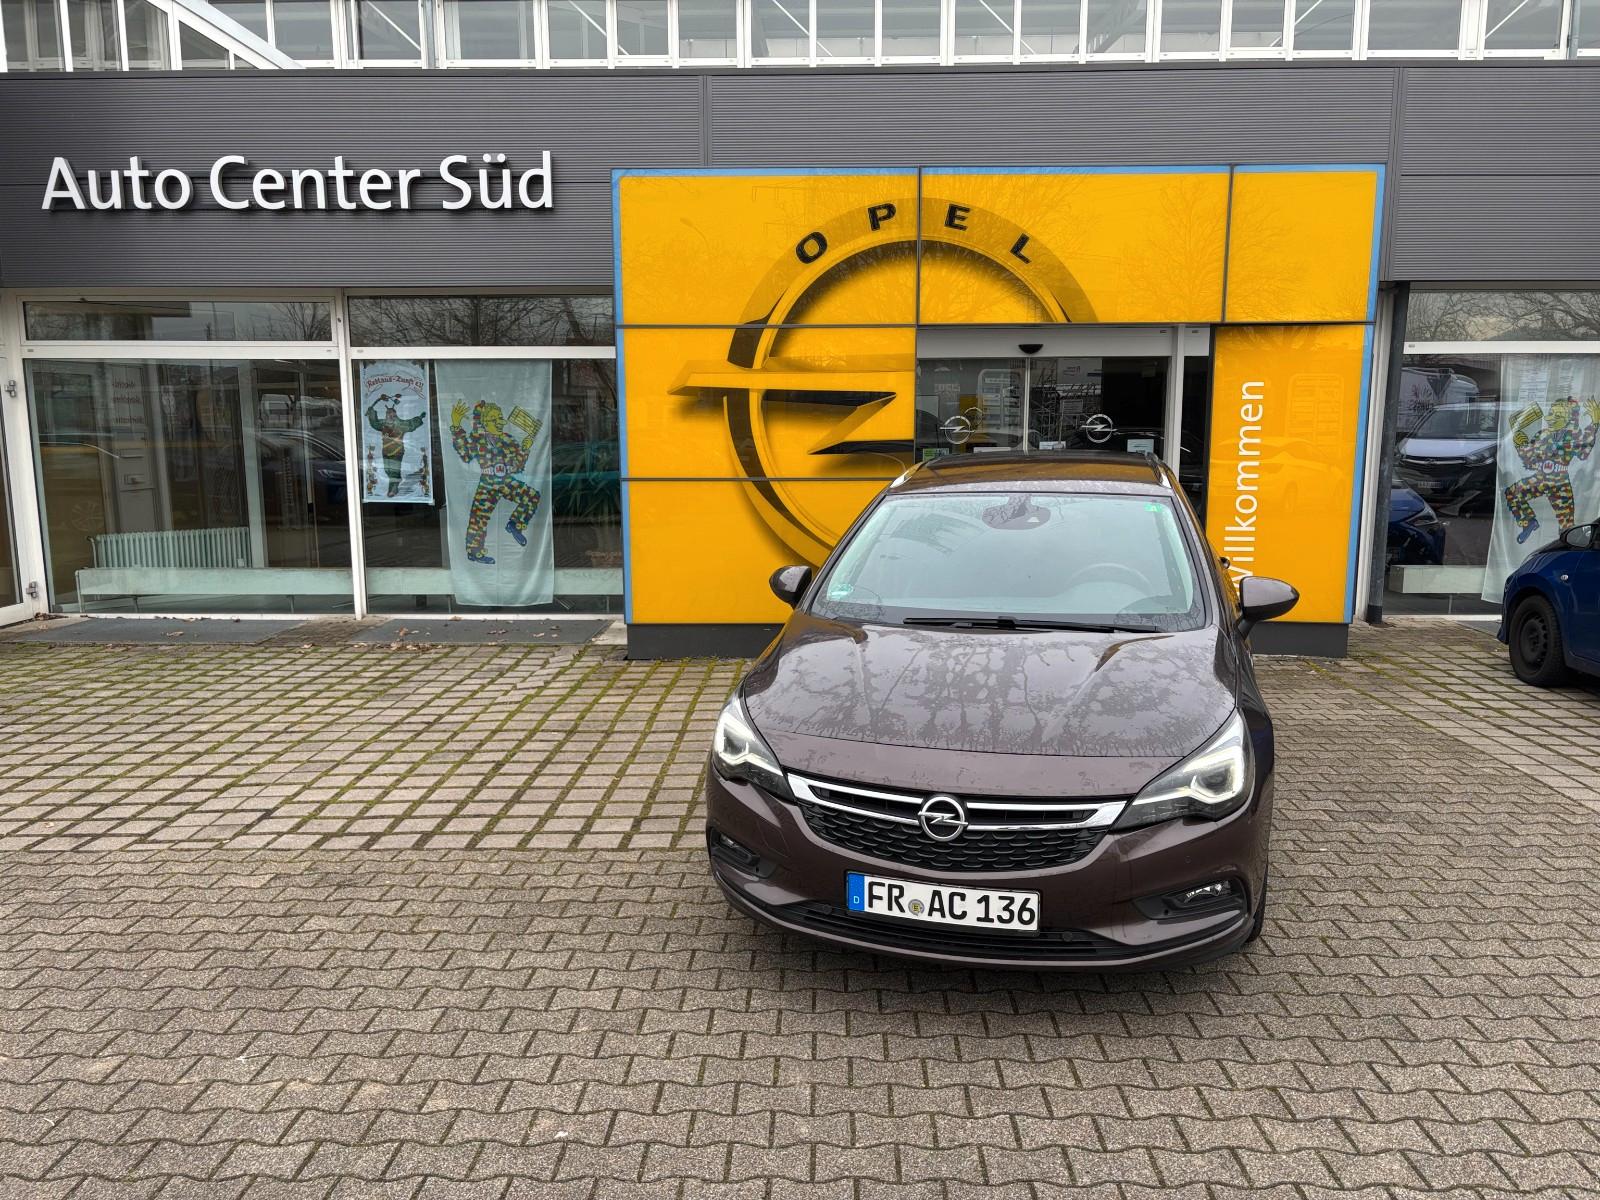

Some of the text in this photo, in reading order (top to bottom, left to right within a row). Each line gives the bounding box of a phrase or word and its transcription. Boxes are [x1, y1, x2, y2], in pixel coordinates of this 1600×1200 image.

[41, 150, 553, 210] Auto Center Süd
[795, 202, 1032, 265] OPEL
[853, 895, 860, 904] D
[867, 881, 1036, 926] FR AC 136
